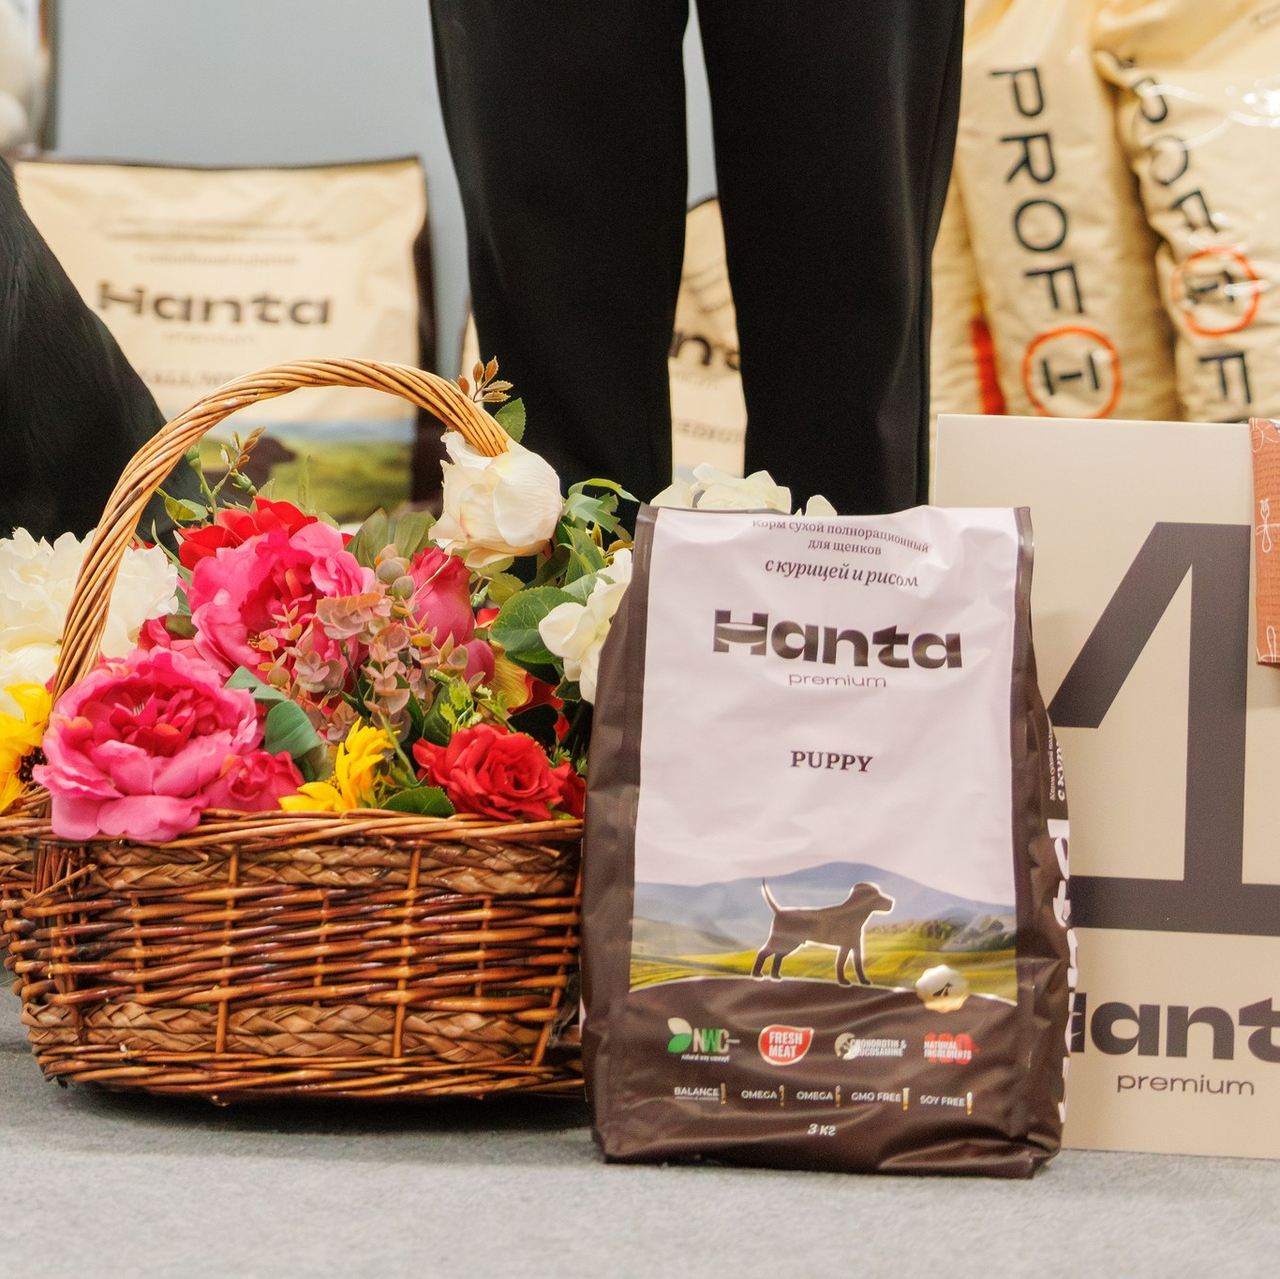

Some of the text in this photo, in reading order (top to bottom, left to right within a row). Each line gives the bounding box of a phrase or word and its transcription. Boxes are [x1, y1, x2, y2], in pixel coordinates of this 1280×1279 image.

[96, 280, 334, 326] Hanta
[788, 519, 824, 533] сухой
[826, 526, 929, 553] полнорационный
[807, 538, 882, 556] для щенков
[765, 558, 919, 588] с курицей и рисом
[713, 608, 962, 669] Hanta
[789, 673, 887, 689] premium
[790, 750, 874, 773] PUPPY
[1070, 992, 1280, 1063] ant
[693, 1027, 730, 1054] NWC
[769, 1032, 803, 1046] FRESH
[768, 1045, 797, 1059] MEAT
[674, 1087, 719, 1097] BALANCE
[1117, 1073, 1255, 1095] premium
[741, 1090, 777, 1099] OMEGA
[796, 1091, 833, 1100] OMEGA
[851, 1091, 901, 1102] GMO FREE
[920, 1095, 965, 1107] SOY FREE
